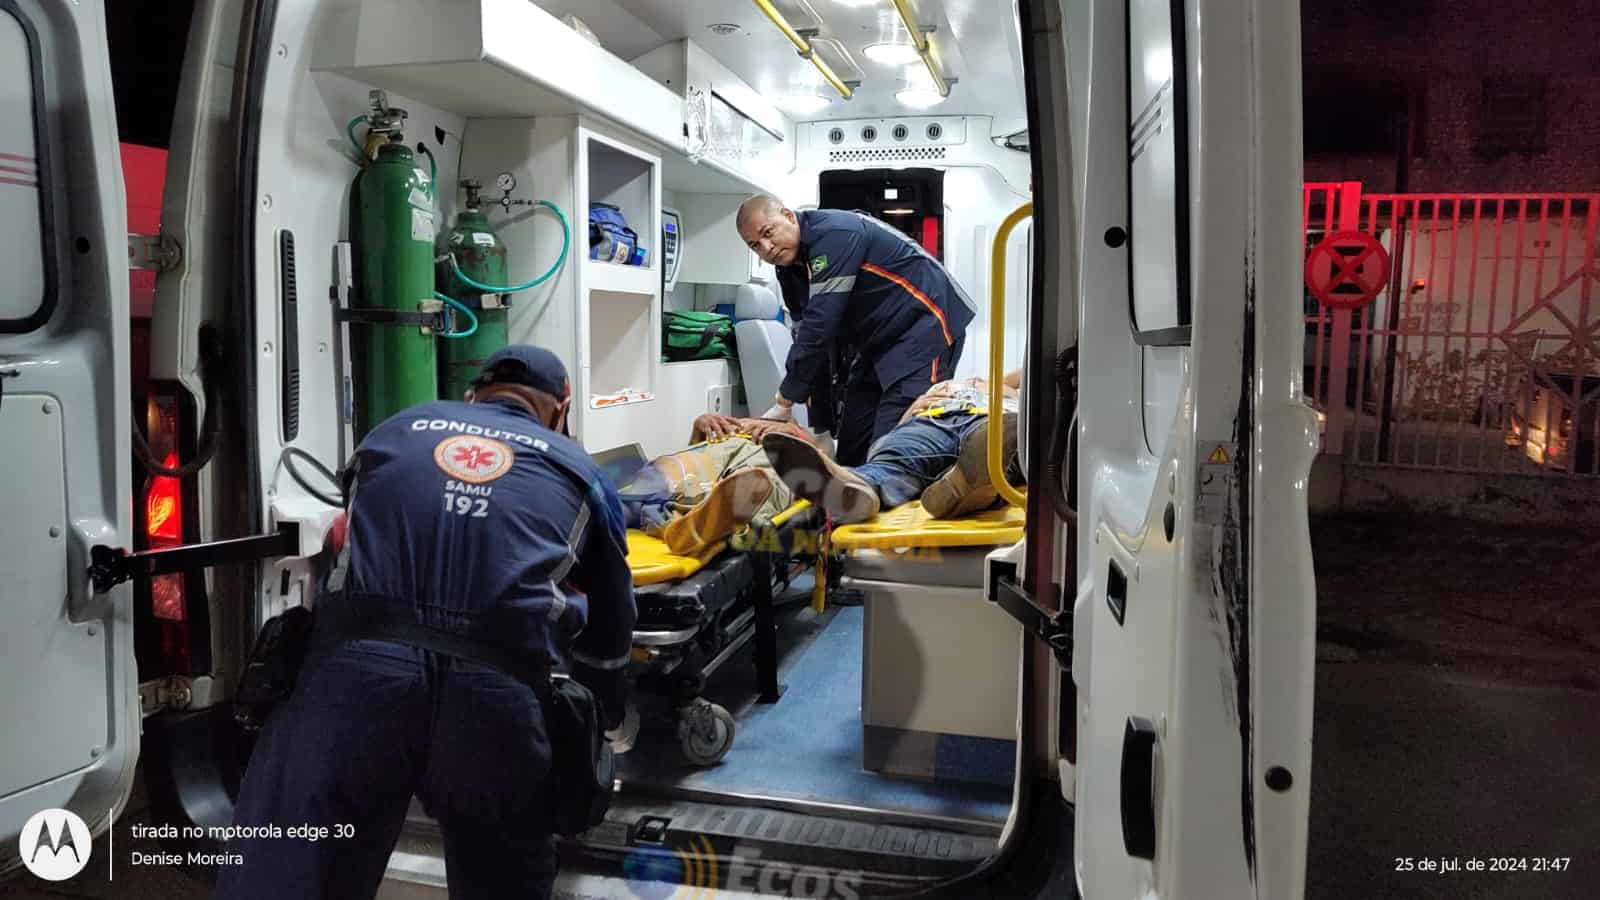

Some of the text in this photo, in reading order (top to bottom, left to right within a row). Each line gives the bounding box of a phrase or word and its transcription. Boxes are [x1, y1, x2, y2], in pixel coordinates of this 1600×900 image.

[411, 419, 550, 452] CONDUTOR
[445, 480, 493, 497] SAMU
[444, 493, 489, 518] 192
